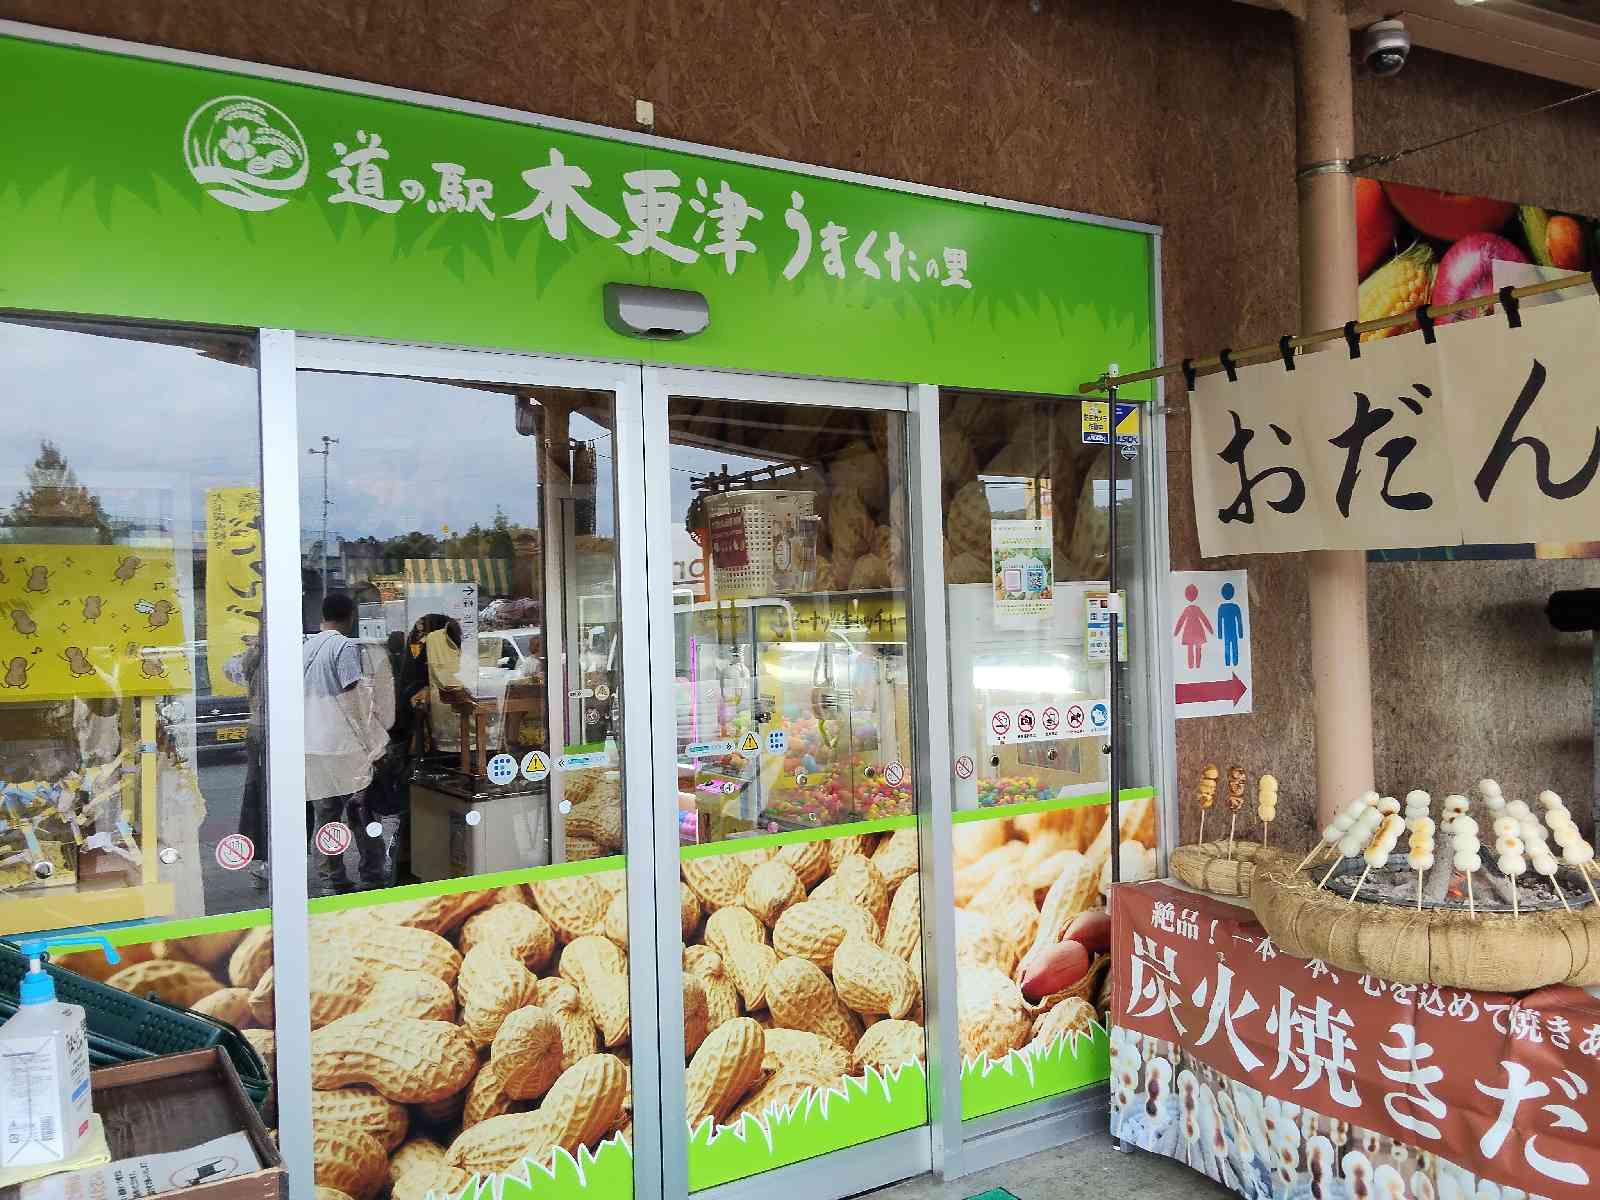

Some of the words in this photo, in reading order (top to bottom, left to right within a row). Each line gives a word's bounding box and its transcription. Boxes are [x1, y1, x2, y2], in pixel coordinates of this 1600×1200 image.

[327, 130, 497, 217] 道の駅
[504, 147, 764, 274] 木更津
[782, 190, 973, 288] うまくたの里
[1217, 359, 1600, 524] おだん
[1127, 931, 1590, 1185] 炭火焼きだ
